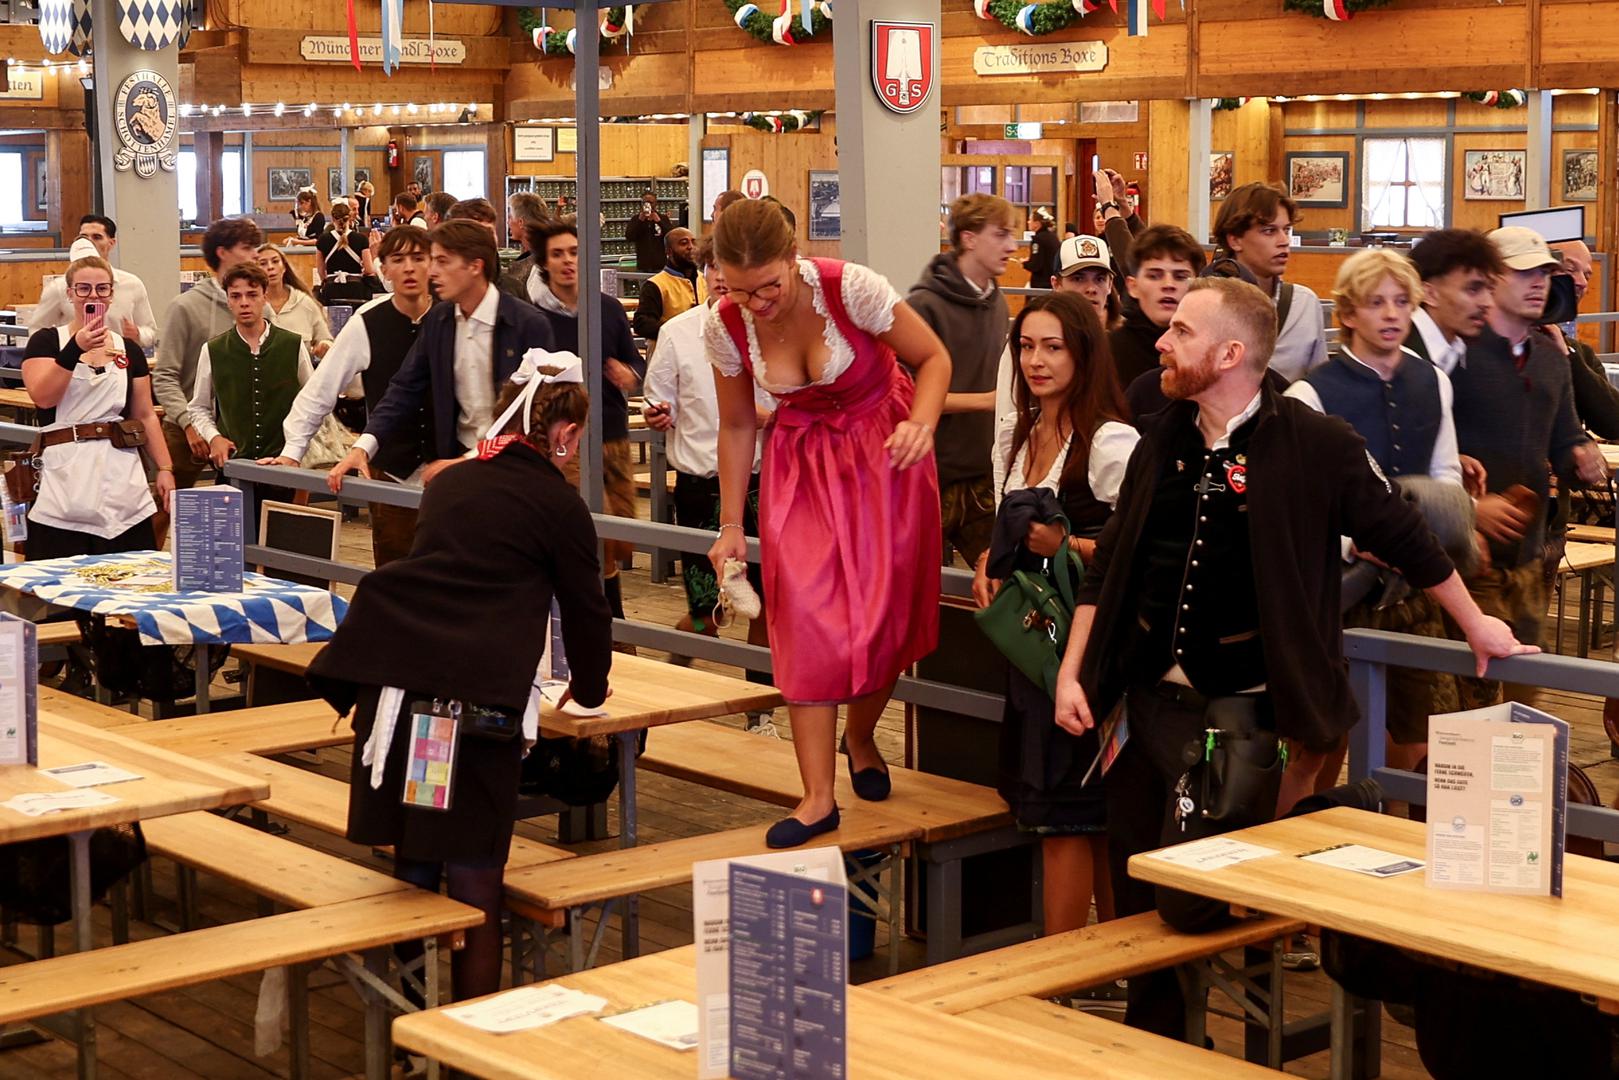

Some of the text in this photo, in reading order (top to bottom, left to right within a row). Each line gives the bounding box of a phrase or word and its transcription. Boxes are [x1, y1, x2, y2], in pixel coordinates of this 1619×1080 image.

[309, 40, 381, 55] Müncner
[982, 48, 1096, 67] Traditions Boxe
[121, 73, 172, 95] FESTHALLE
[886, 83, 922, 97] G S
[118, 112, 175, 153] SCHOTTENHAMEL
